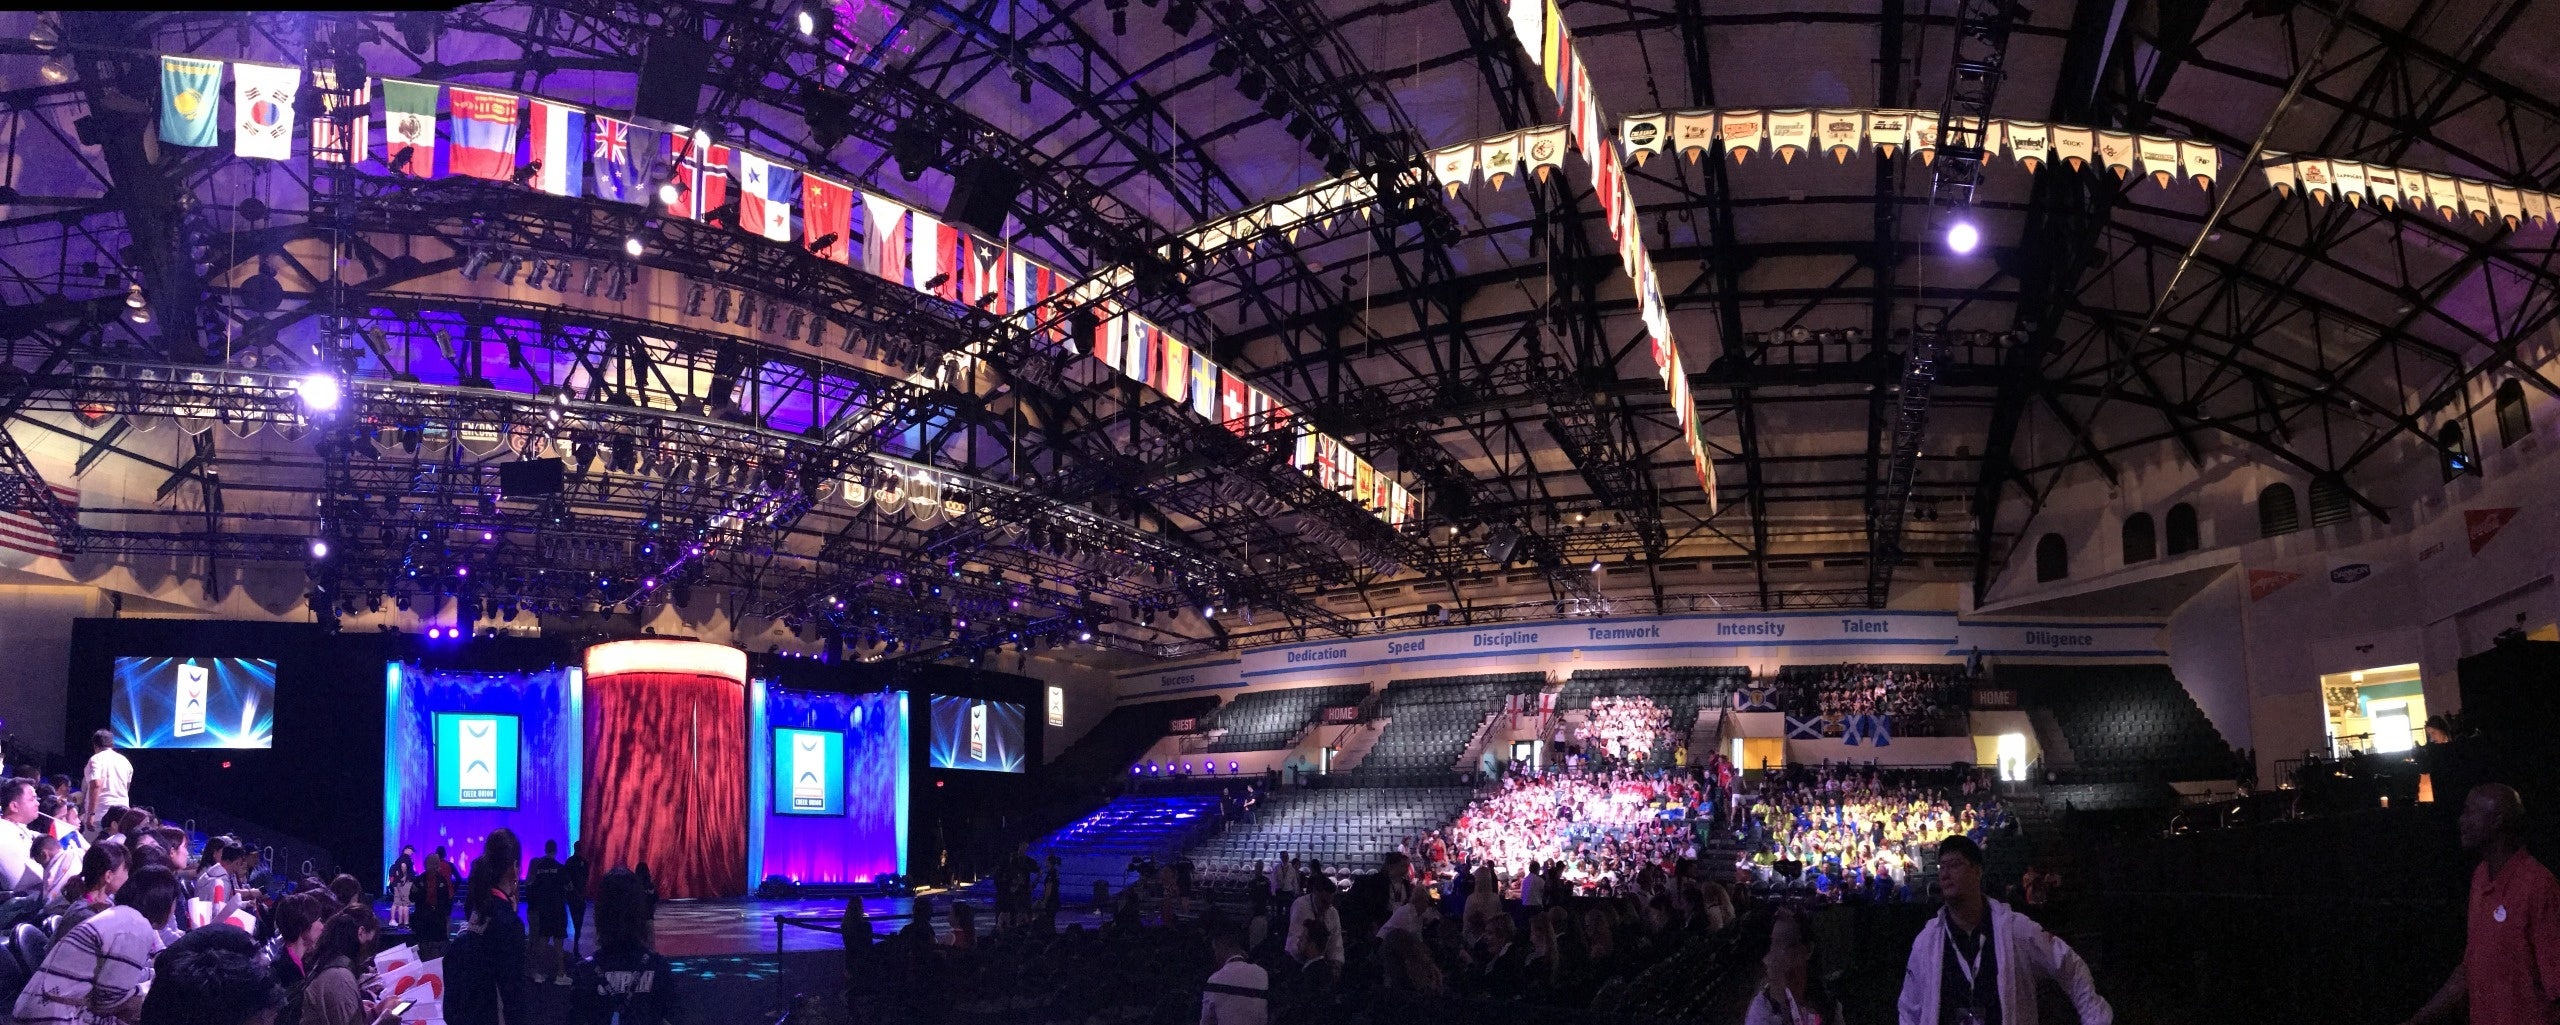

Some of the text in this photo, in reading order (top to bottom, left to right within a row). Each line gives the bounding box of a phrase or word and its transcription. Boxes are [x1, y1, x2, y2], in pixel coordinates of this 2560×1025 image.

[1588, 624, 1660, 640] Teamwork
[1717, 621, 1785, 637] Intensity
[1842, 619, 1889, 634] Talent
[1388, 638, 1425, 655] Speed
[1473, 631, 1538, 648] Discipline
[2025, 631, 2093, 648] Diligence
[1287, 648, 1347, 663] Dedication
[1161, 673, 1196, 688] Success
[1980, 691, 2010, 705] HOME
[1328, 706, 1353, 720] HOME
[1172, 718, 1194, 731] GUEST
